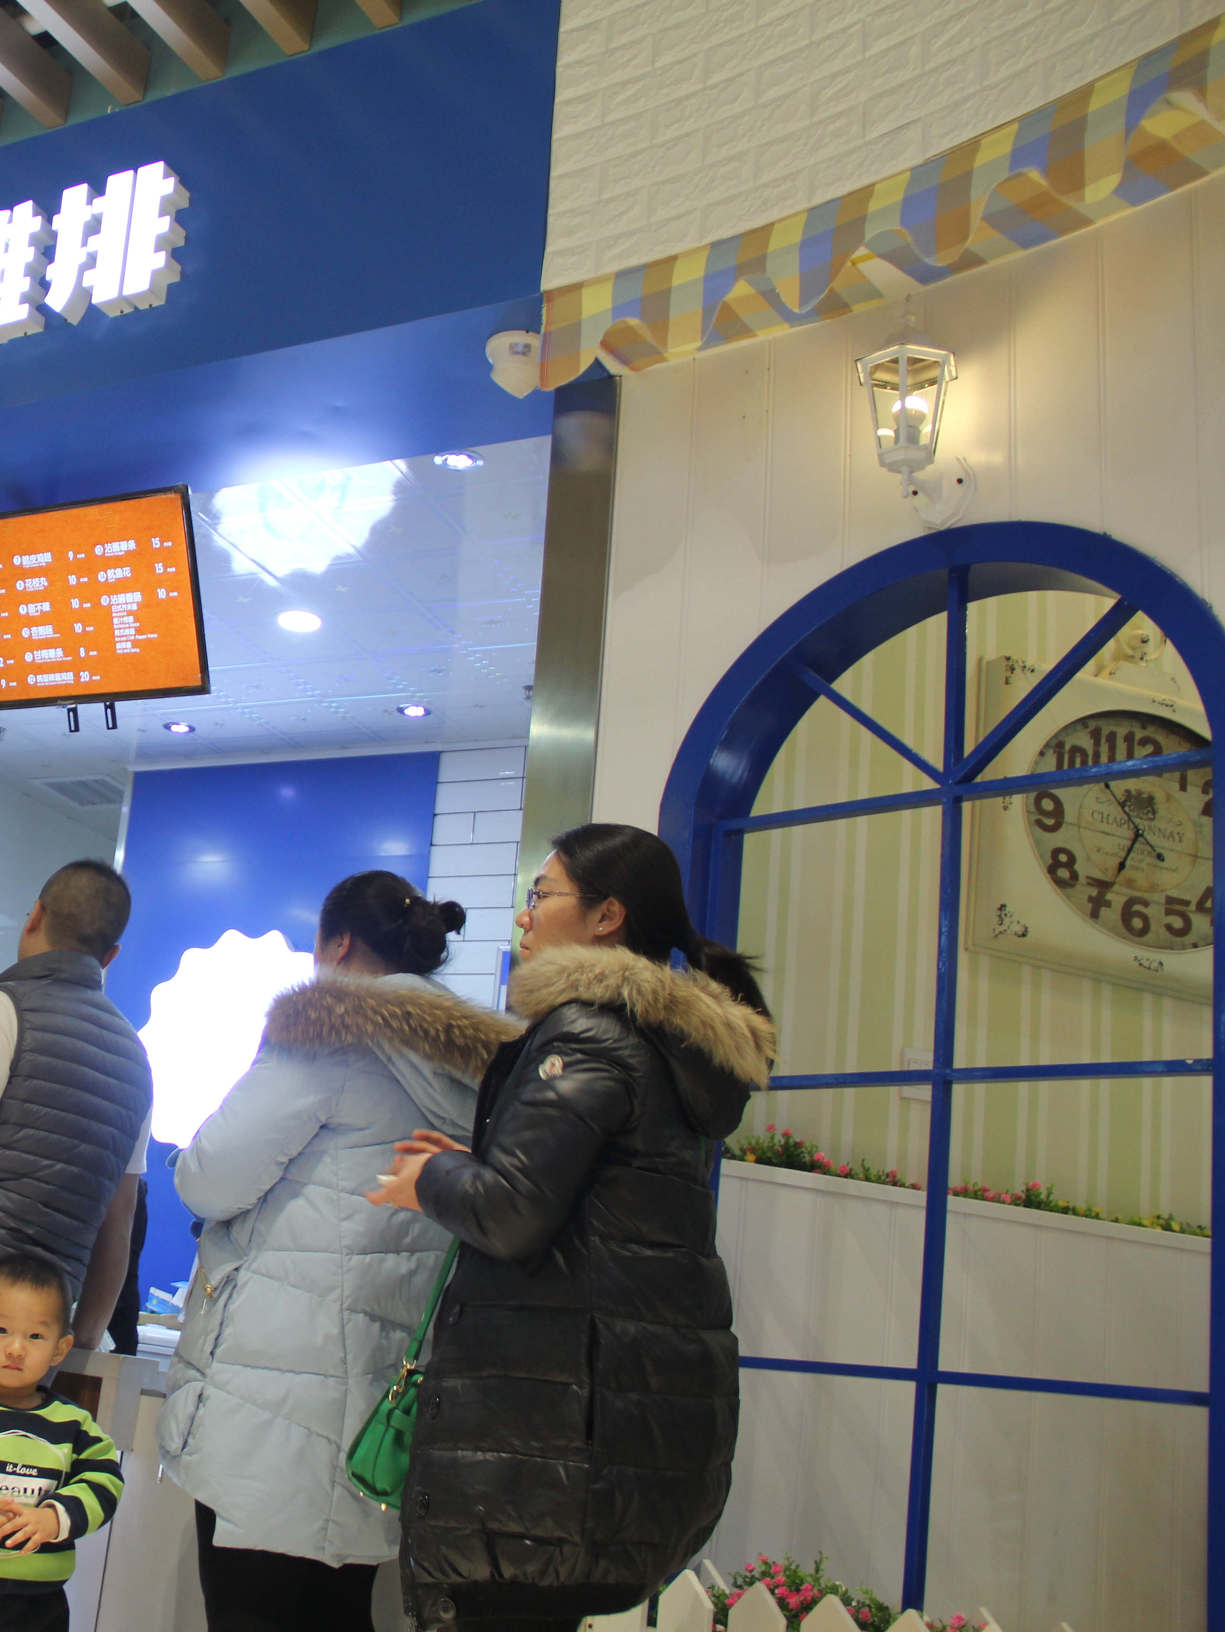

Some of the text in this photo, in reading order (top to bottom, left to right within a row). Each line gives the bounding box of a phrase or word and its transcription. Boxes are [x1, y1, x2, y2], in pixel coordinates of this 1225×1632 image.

[152, 537, 161, 548] 15
[68, 550, 74, 561] 9
[154, 562, 164, 574] 15
[68, 574, 77, 585] 10
[157, 588, 167, 599] 10
[71, 598, 80, 609] 10
[73, 622, 83, 633] 10
[79, 647, 85, 658] 8
[79, 671, 90, 682] 20
[0, 678, 6, 689] 9
[1033, 790, 1065, 833] 9
[1047, 846, 1080, 889] 8
[1085, 874, 1115, 920] 7
[1120, 895, 1151, 938] 6
[1163, 894, 1193, 938] 5
